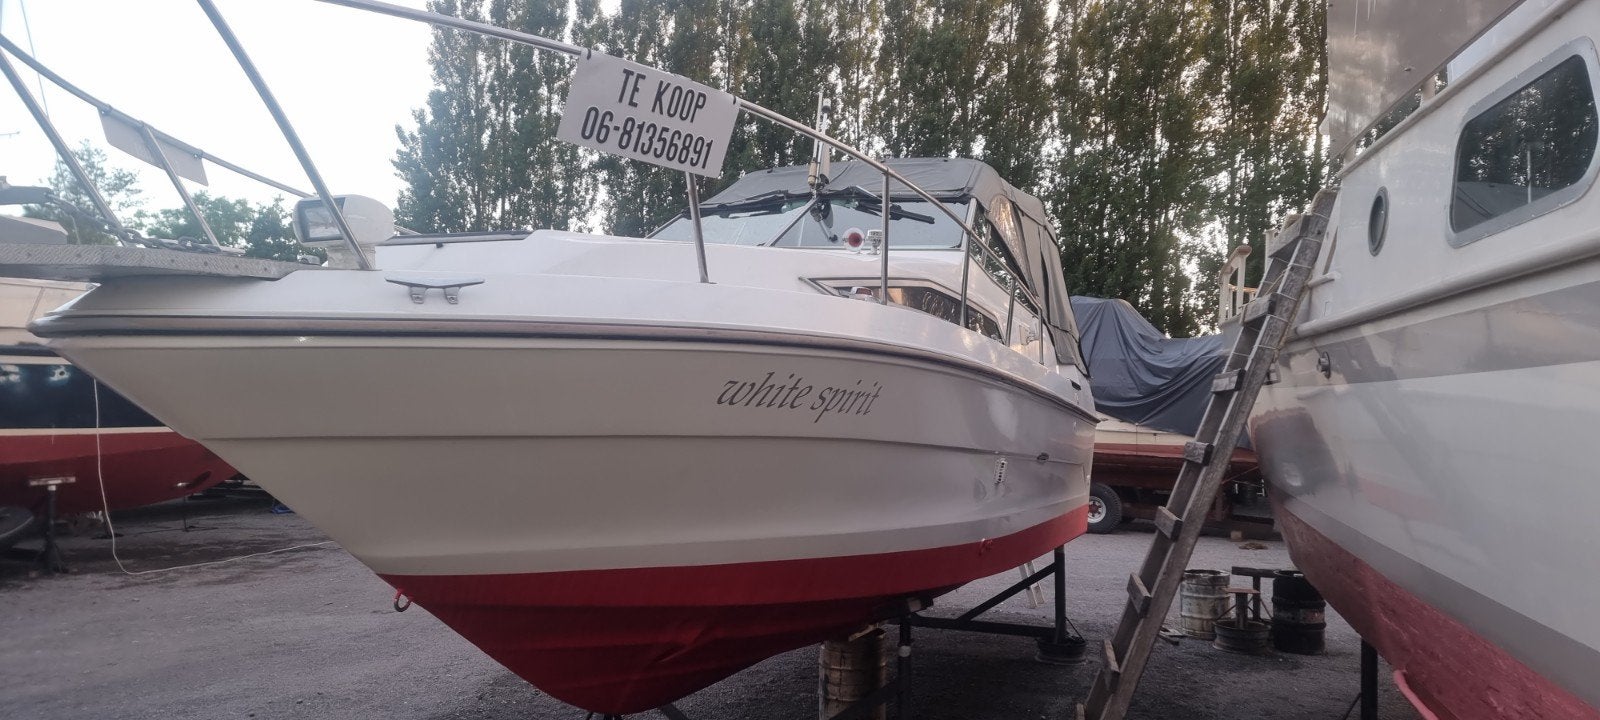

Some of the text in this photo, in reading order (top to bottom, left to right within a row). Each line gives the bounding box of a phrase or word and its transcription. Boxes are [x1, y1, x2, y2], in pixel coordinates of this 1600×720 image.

[618, 68, 707, 123] TE KOOP
[581, 106, 713, 169] 06-81356891
[716, 371, 883, 423] white spirit
